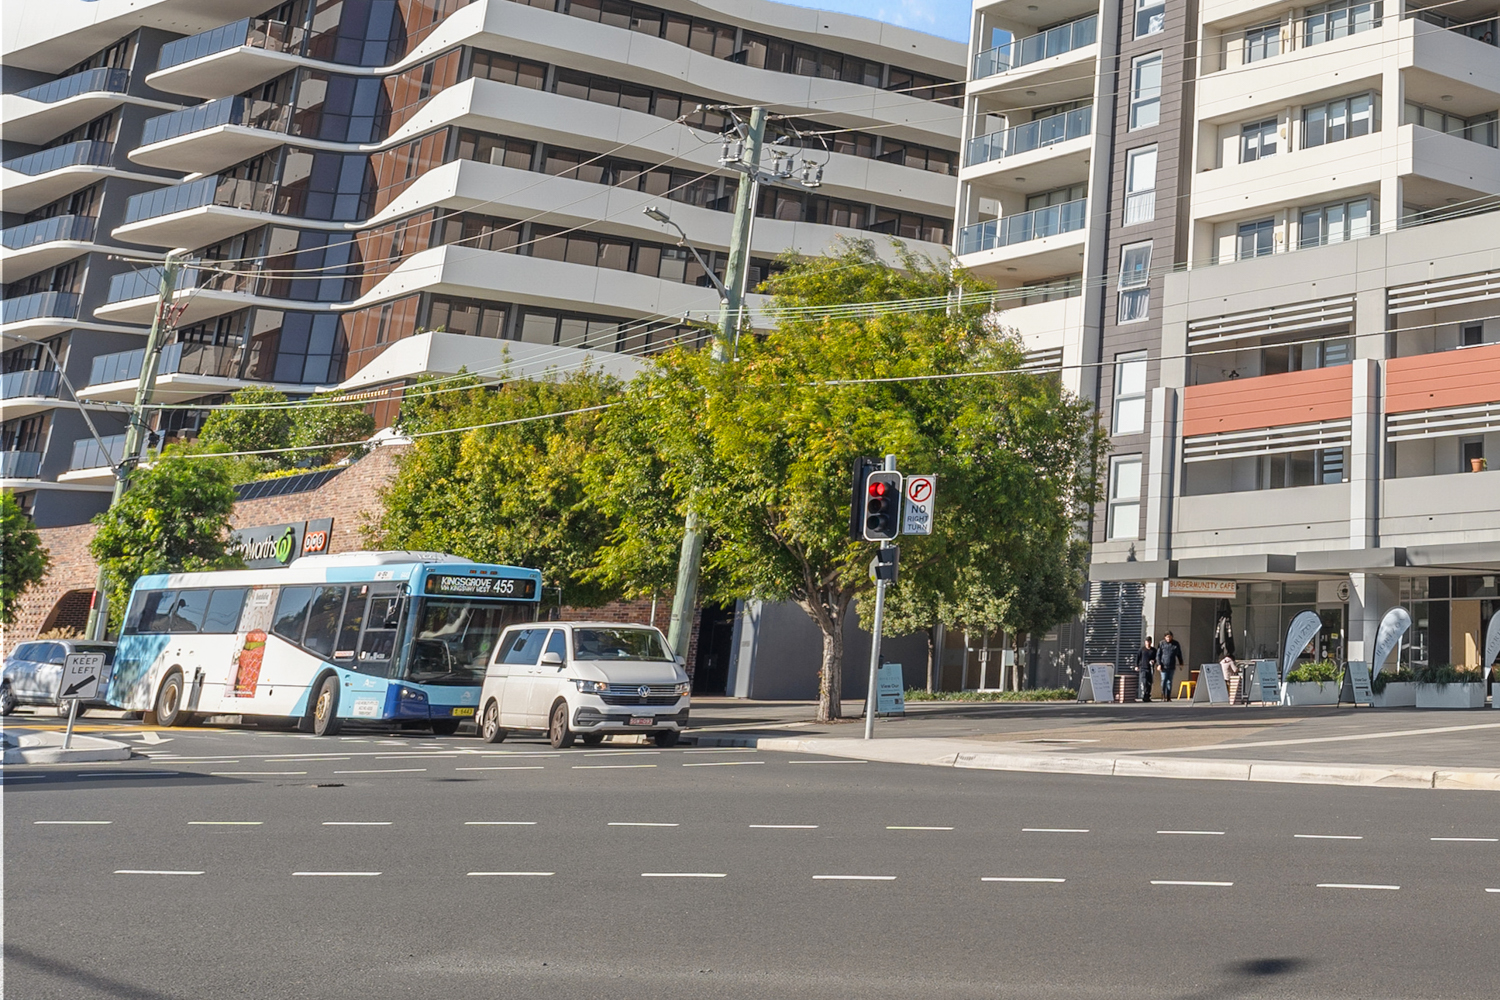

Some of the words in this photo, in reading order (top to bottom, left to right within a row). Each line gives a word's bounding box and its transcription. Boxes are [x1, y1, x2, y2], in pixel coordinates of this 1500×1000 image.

[911, 504, 926, 513] NO
[907, 515, 929, 523] RIGHT
[907, 523, 928, 531] TURN
[441, 576, 493, 587] KINGSGROVE
[1169, 580, 1218, 589] BURGERMUNITY
[1219, 582, 1235, 590] CAFE
[493, 580, 515, 594] 455
[72, 657, 98, 665] KEEP
[71, 666, 95, 674] LEFT
